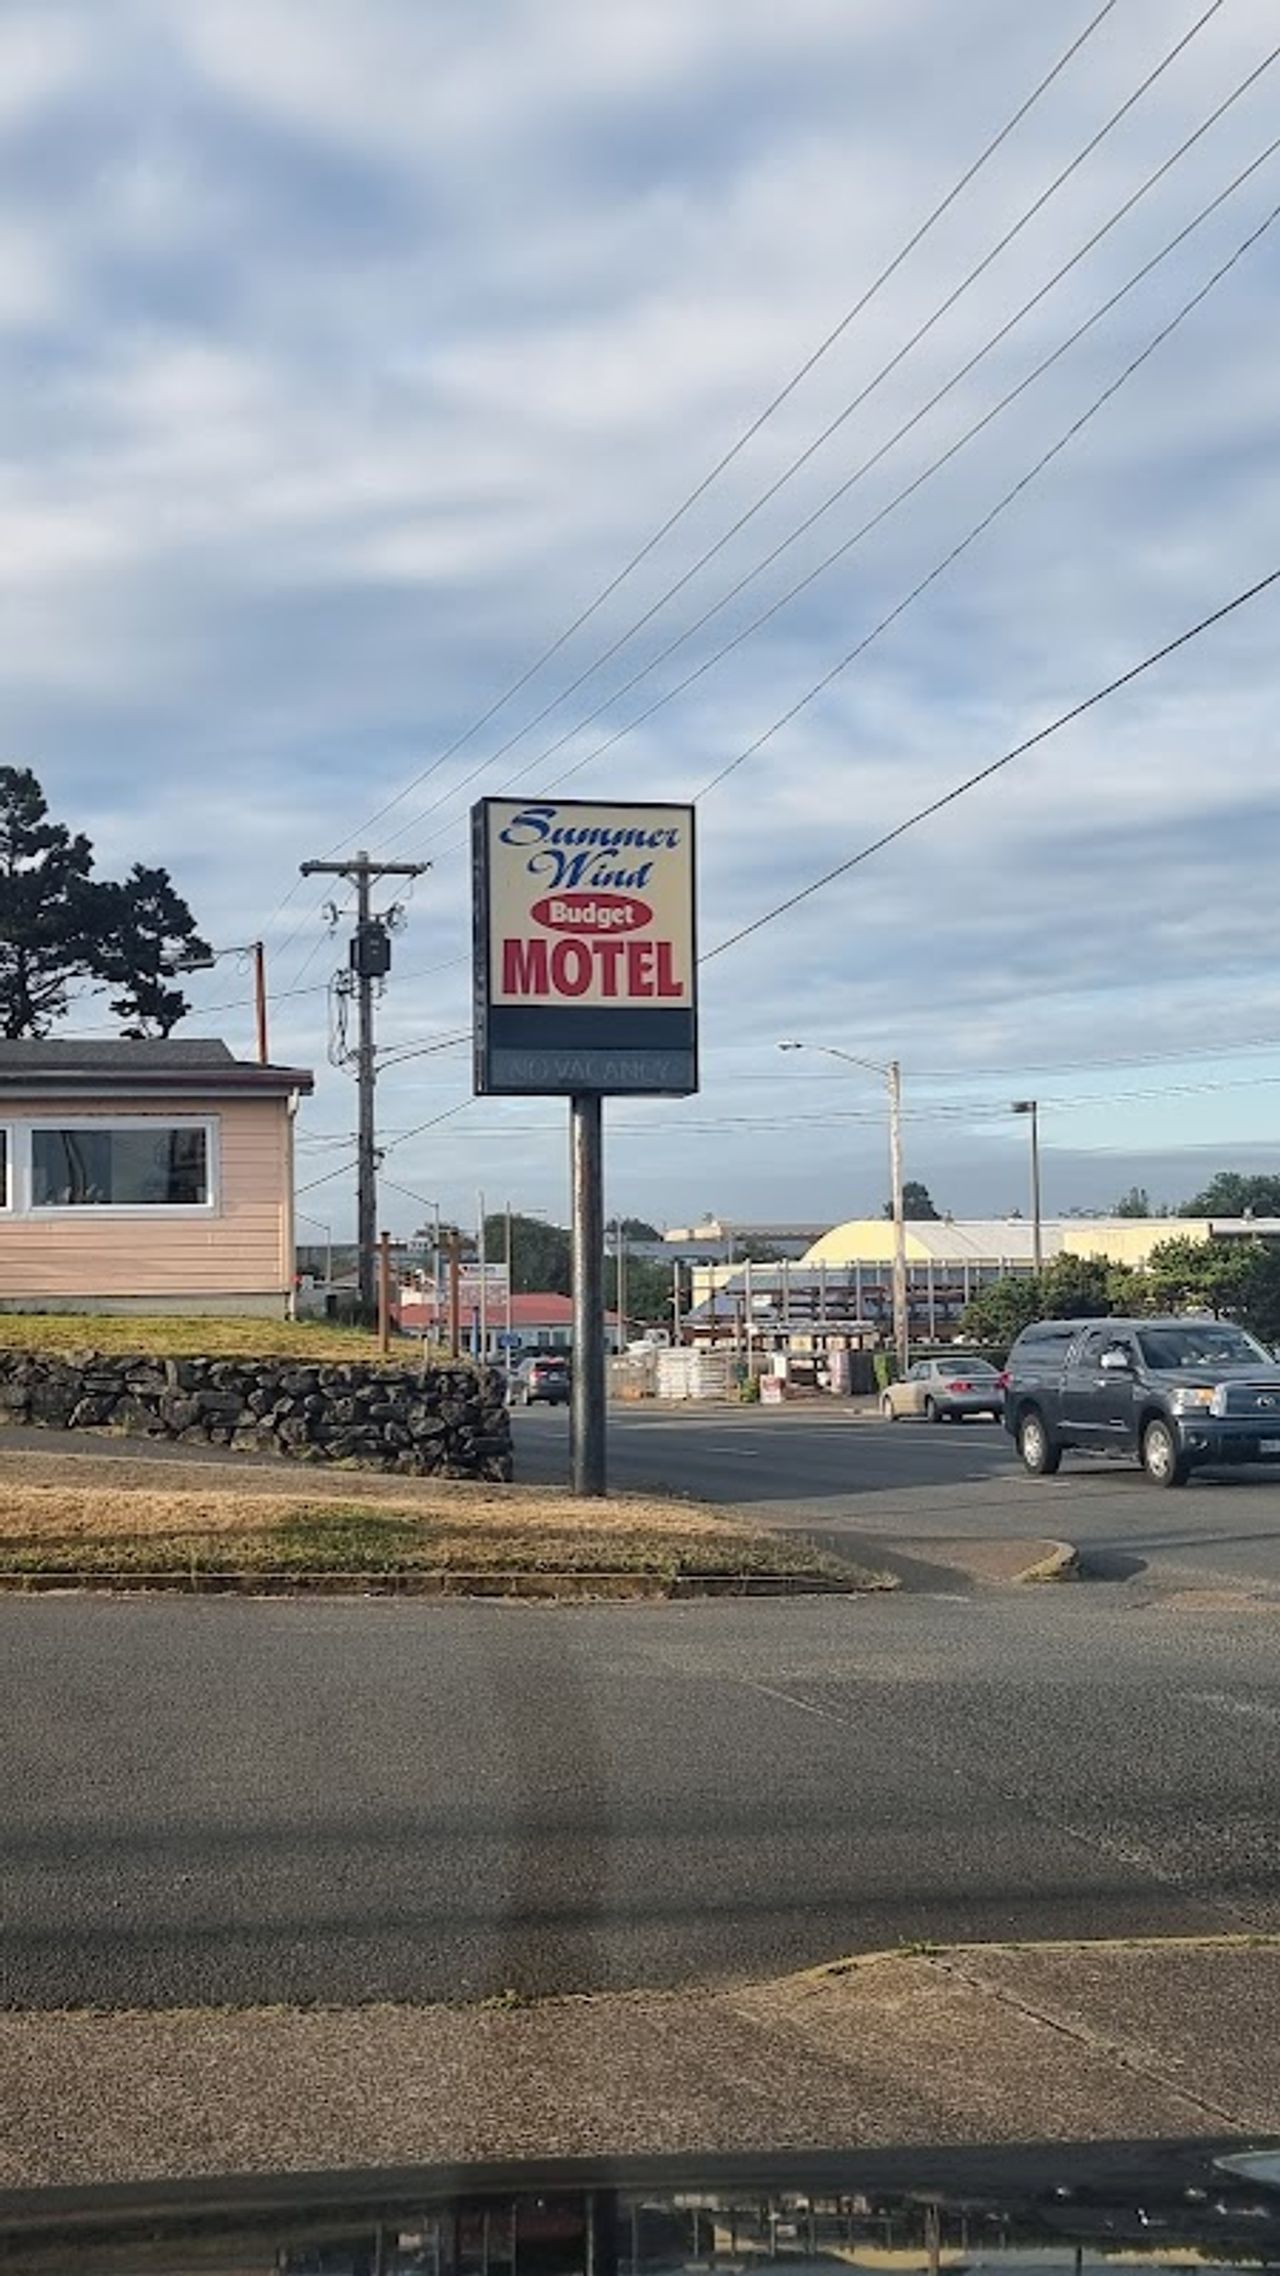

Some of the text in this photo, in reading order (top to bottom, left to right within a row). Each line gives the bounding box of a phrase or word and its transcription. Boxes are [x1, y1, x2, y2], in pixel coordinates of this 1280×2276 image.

[498, 808, 680, 848] Summer
[527, 849, 653, 888] Wind
[550, 902, 635, 928] Budget
[502, 939, 684, 997] MOTEL
[508, 1057, 671, 1081] NO VACANCY
